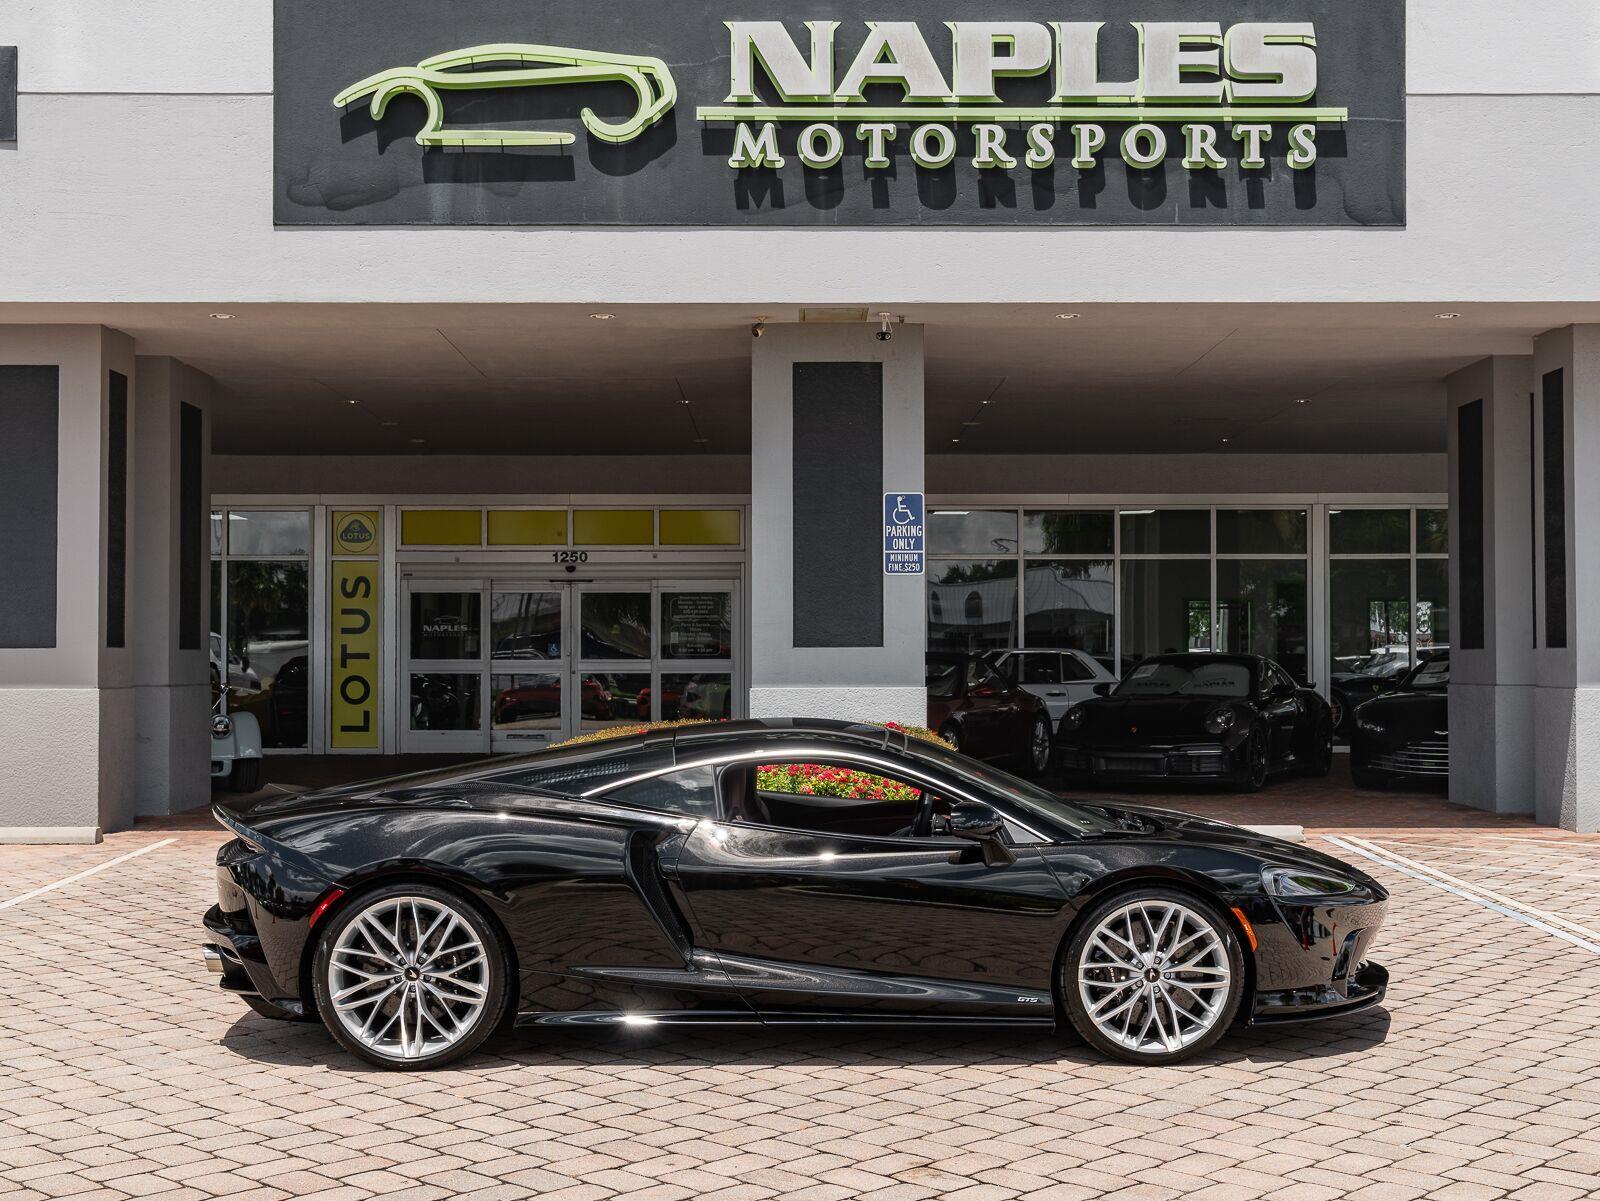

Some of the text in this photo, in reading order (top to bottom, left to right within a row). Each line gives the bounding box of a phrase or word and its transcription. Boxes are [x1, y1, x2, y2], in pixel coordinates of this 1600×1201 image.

[723, 20, 1317, 103] NAPLES
[728, 123, 1318, 170] MOTORSPORTS
[342, 532, 370, 540] LOTUS
[886, 525, 922, 537] PARKING
[892, 538, 916, 550] ONLY
[552, 551, 588, 563] 1250
[890, 553, 919, 562] MINIMUM
[888, 563, 920, 572] FINE $250
[340, 575, 371, 733] LOTUS
